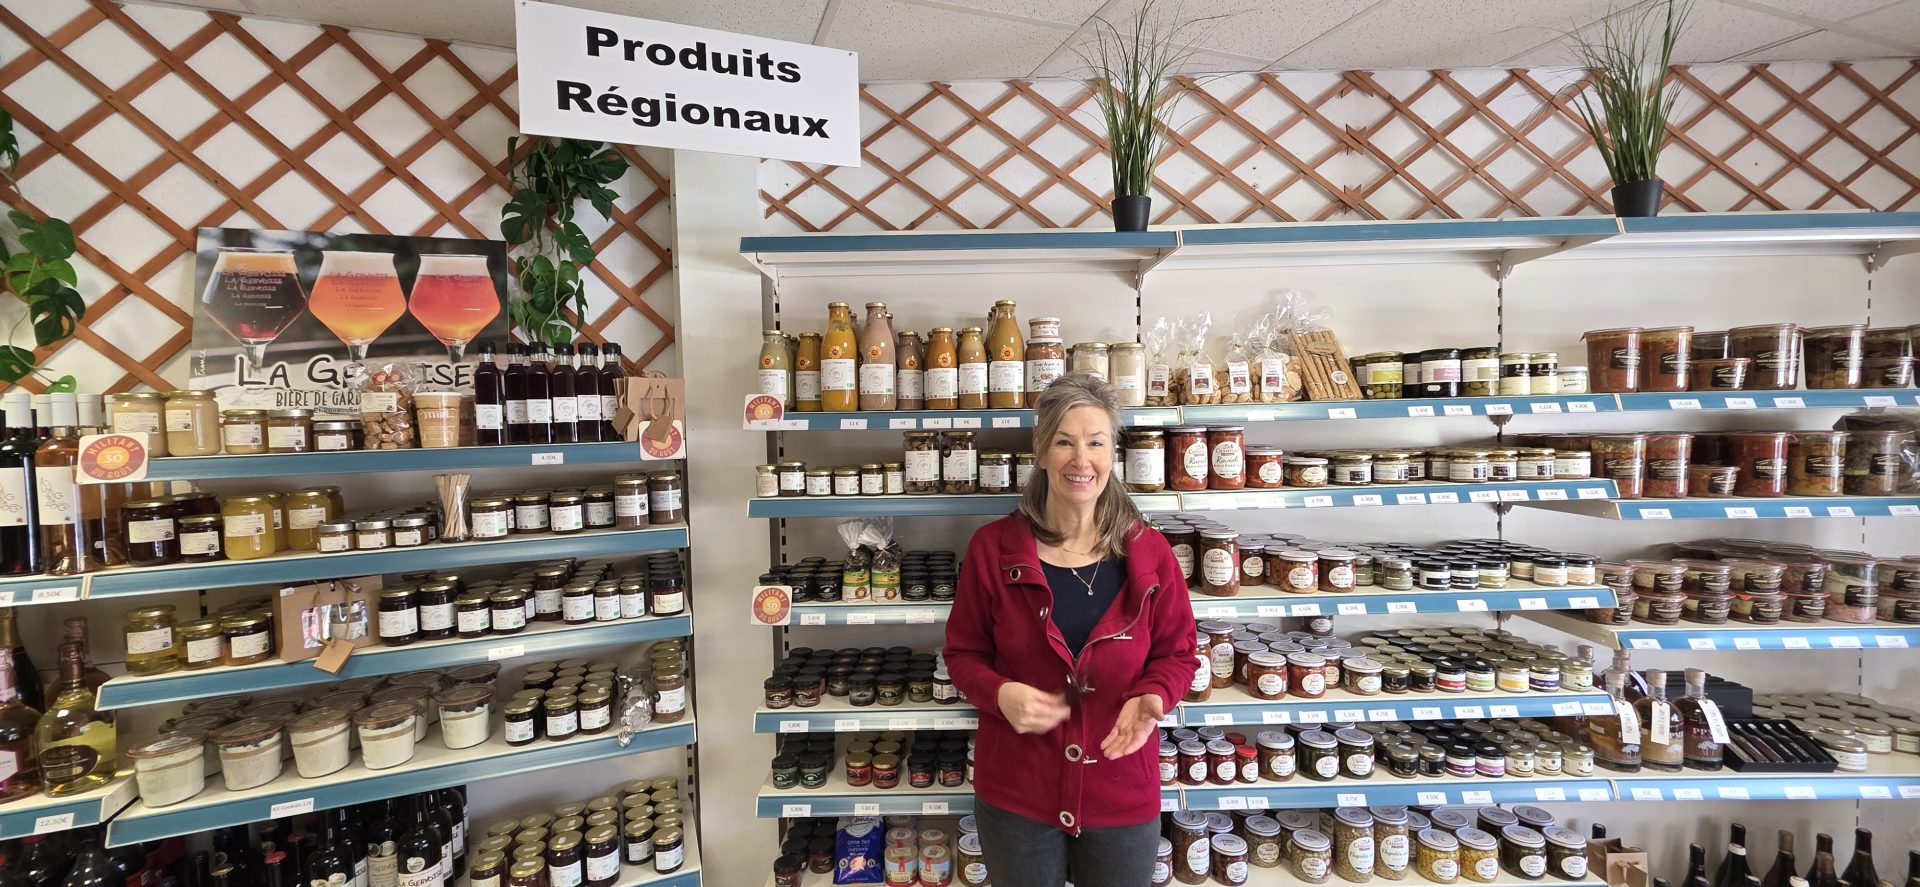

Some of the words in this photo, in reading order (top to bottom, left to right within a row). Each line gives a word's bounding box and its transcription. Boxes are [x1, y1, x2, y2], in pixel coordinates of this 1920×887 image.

[585, 25, 801, 84] Produits
[556, 79, 830, 139] Régionaux
[237, 355, 291, 388] LA
[276, 390, 310, 407] BIÈRE
[314, 391, 328, 406] DE
[87, 437, 140, 454] MILITANT
[103, 453, 124, 463] 30
[91, 466, 105, 477] DU
